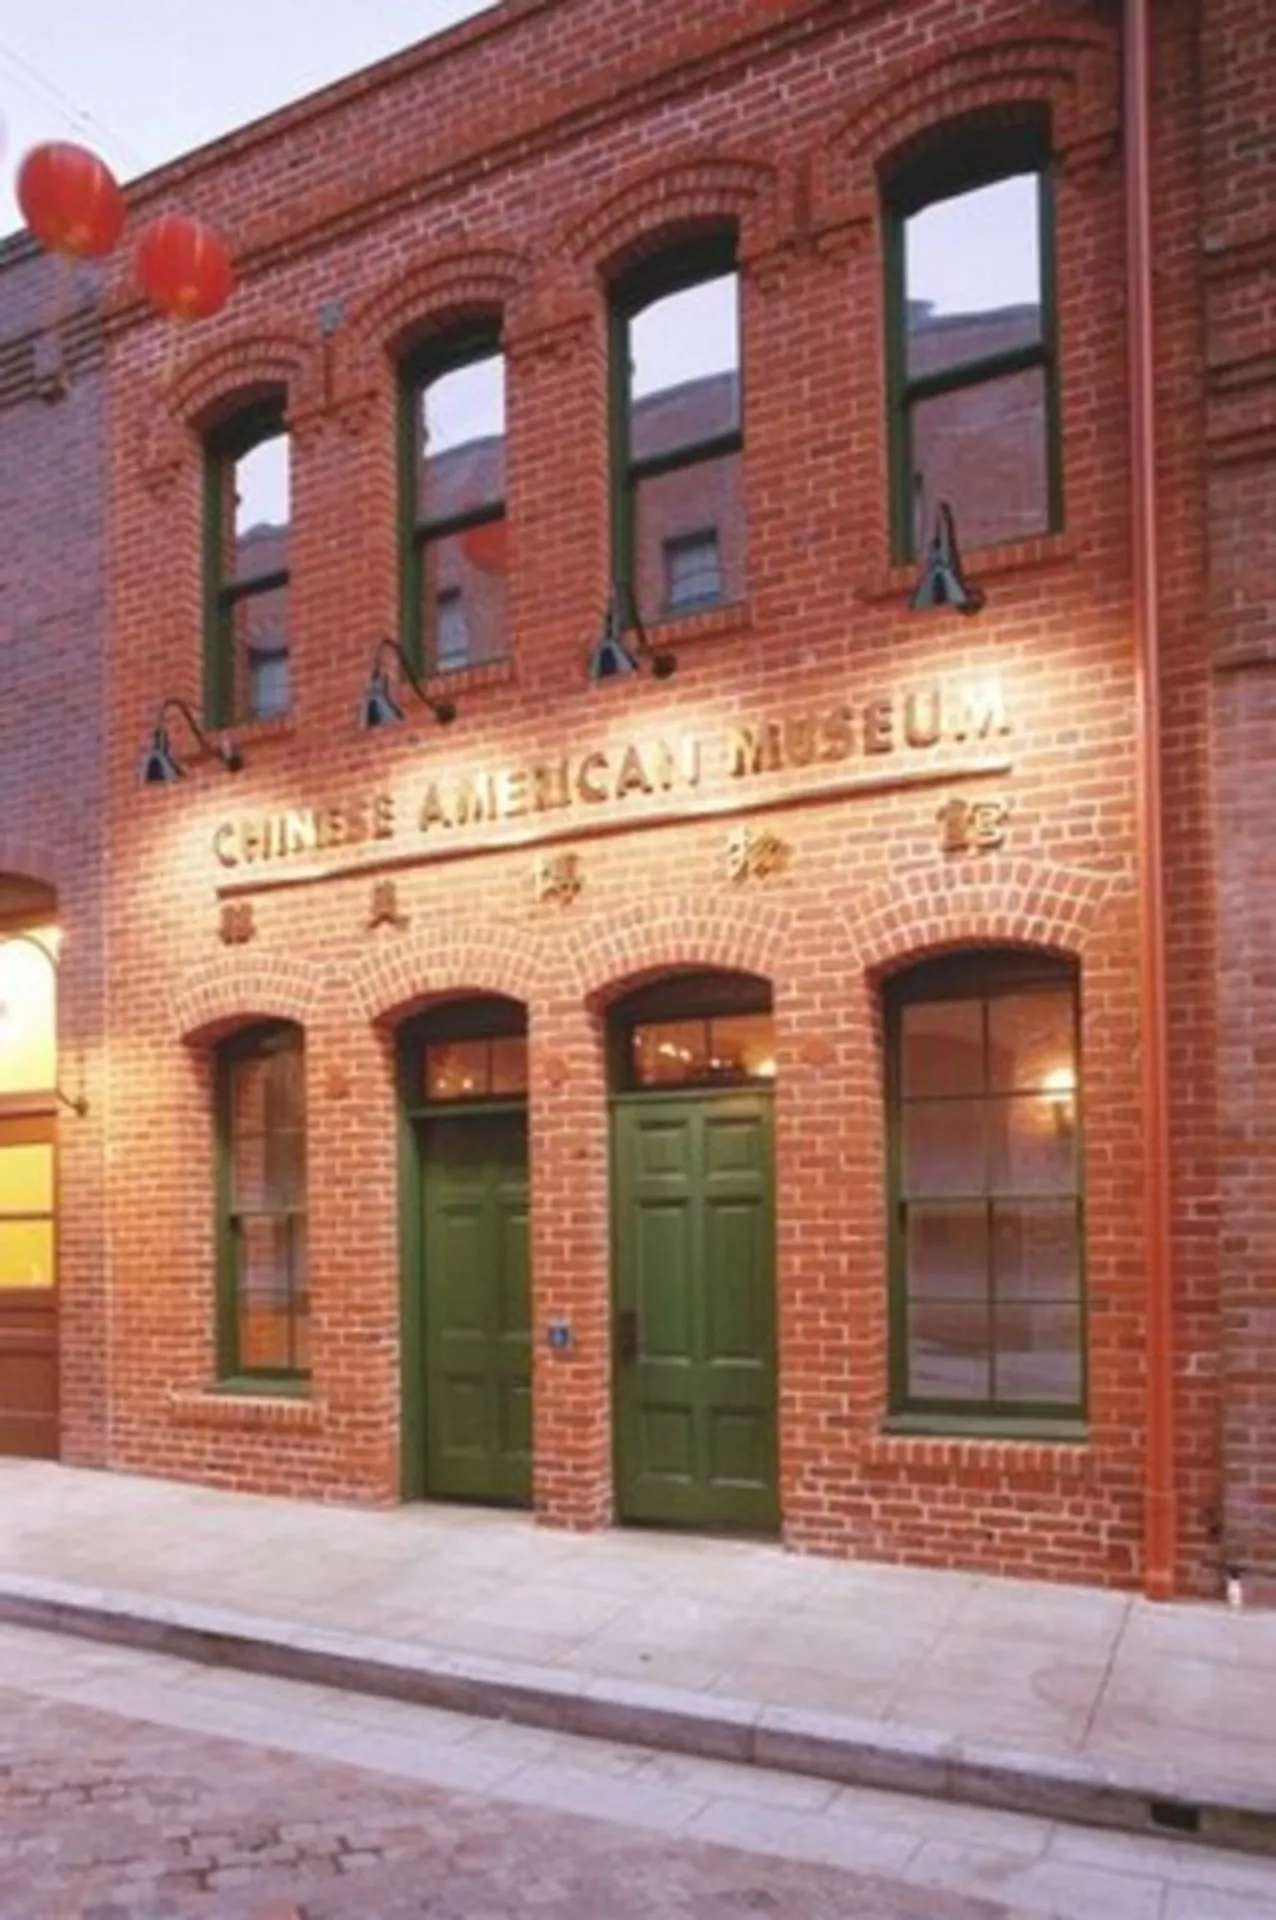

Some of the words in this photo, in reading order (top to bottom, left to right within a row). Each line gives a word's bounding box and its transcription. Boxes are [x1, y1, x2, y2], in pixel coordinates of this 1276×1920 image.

[213, 794, 395, 867] CHINESE
[418, 738, 699, 832] AMERICAN
[730, 682, 1011, 778] MUSEUM
